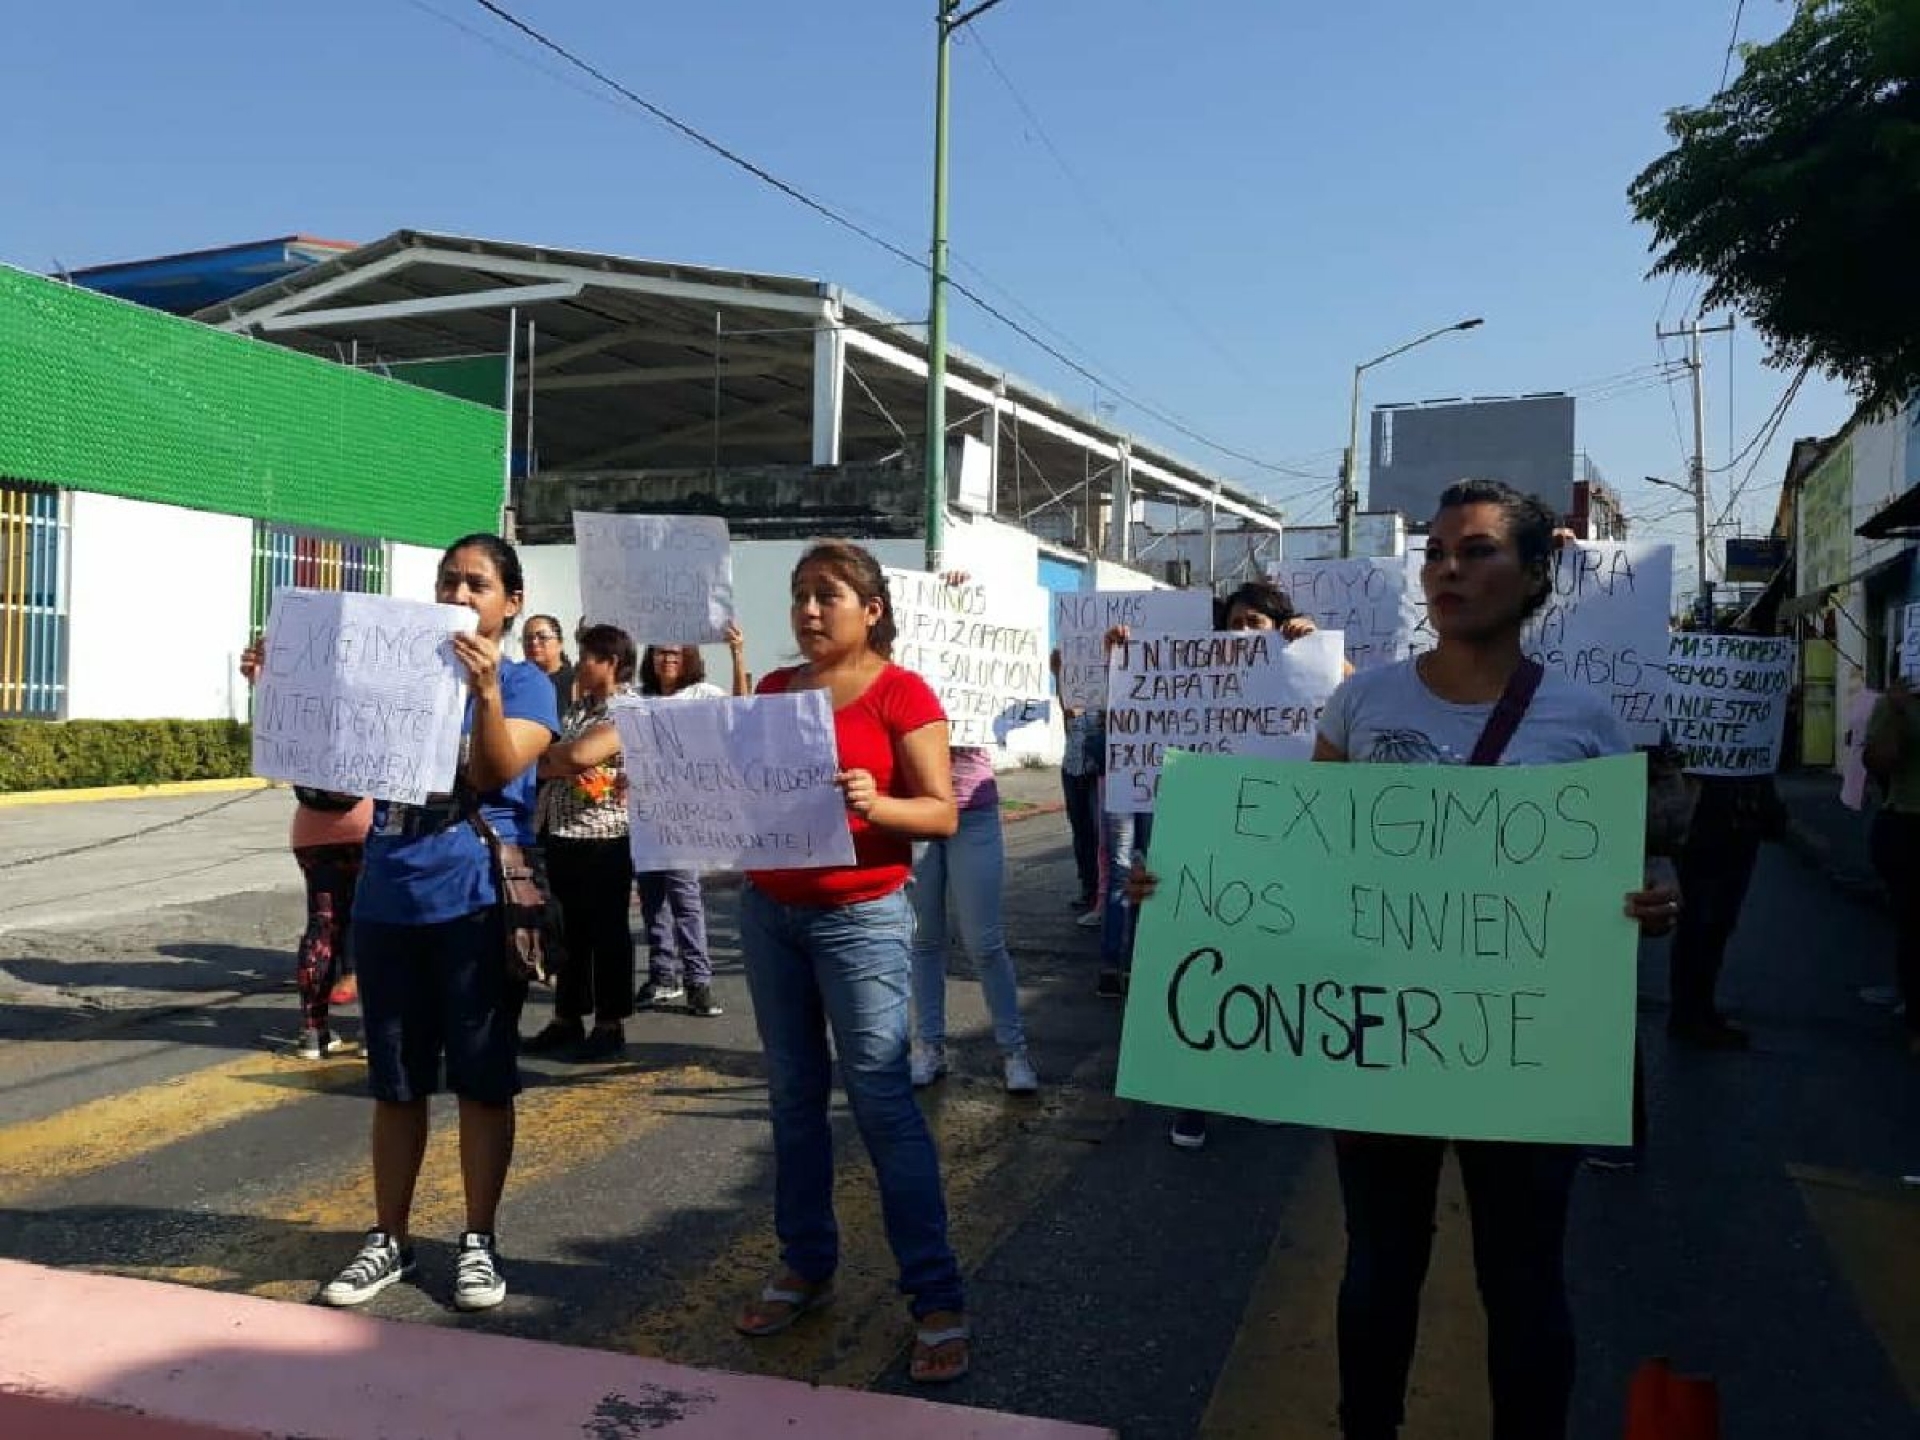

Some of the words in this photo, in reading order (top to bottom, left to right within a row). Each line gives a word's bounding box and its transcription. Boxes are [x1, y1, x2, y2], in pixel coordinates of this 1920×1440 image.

[1058, 596, 1098, 630] NO
[1108, 706, 1142, 736] NO
[1144, 706, 1200, 736] MAS
[1234, 777, 1600, 868] EXIGIMOS
[1175, 854, 1296, 935] NOS
[1351, 884, 1552, 960] ENVIEN
